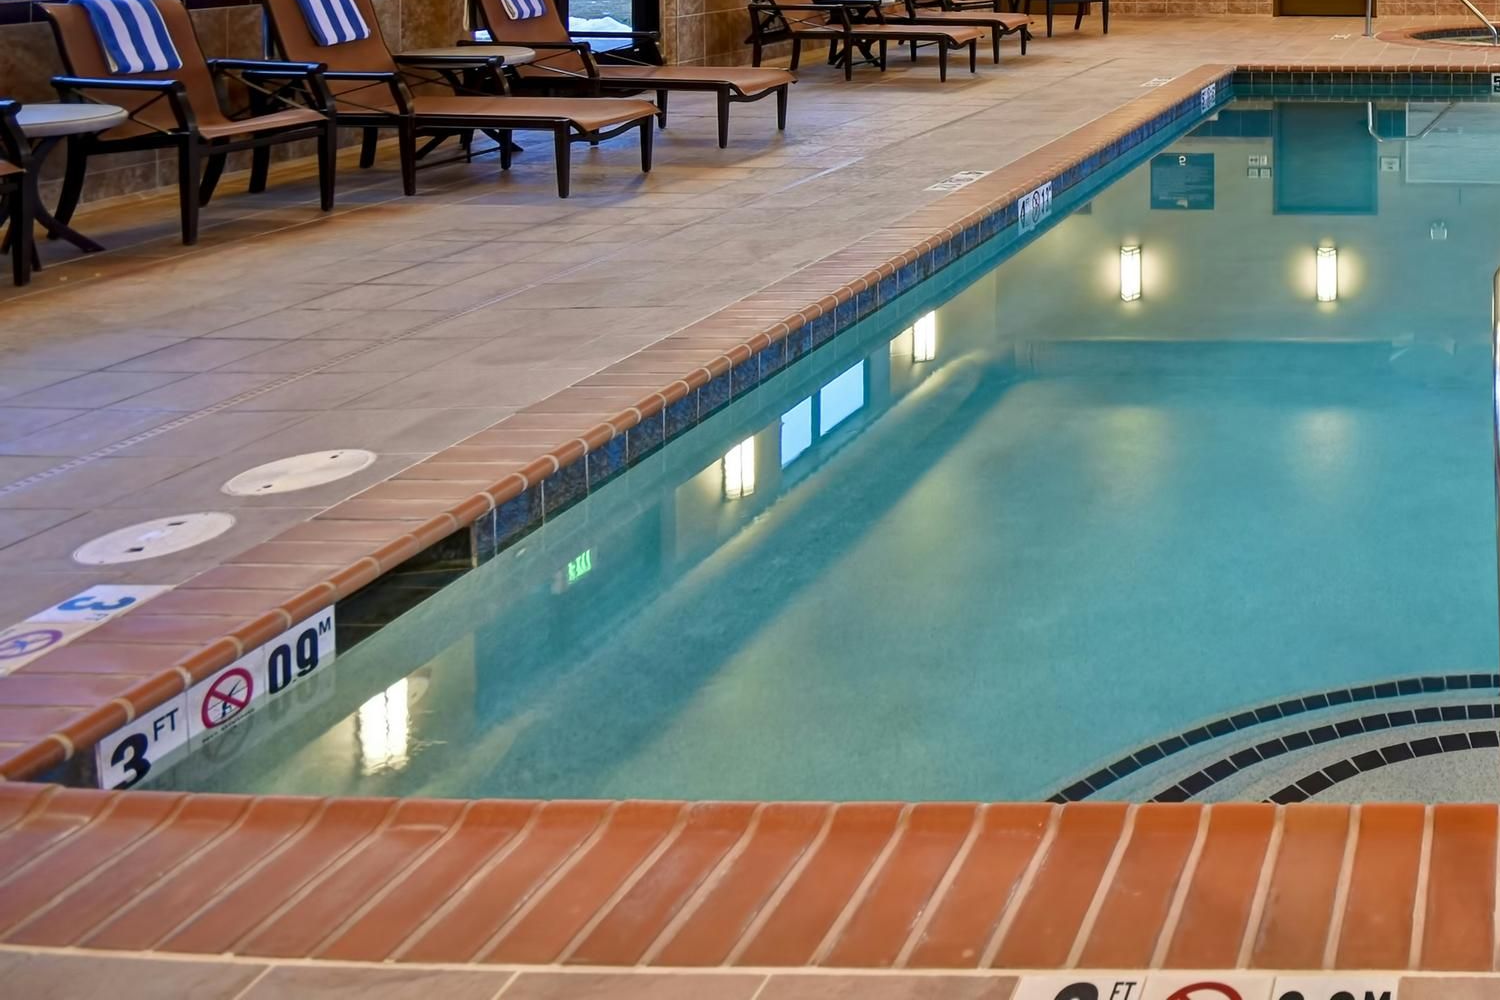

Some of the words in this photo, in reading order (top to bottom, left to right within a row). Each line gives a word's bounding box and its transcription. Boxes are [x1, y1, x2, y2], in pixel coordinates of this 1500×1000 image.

[57, 596, 137, 611] 3
[110, 732, 152, 790] 3
[153, 707, 179, 742] FT
[318, 616, 332, 636] M
